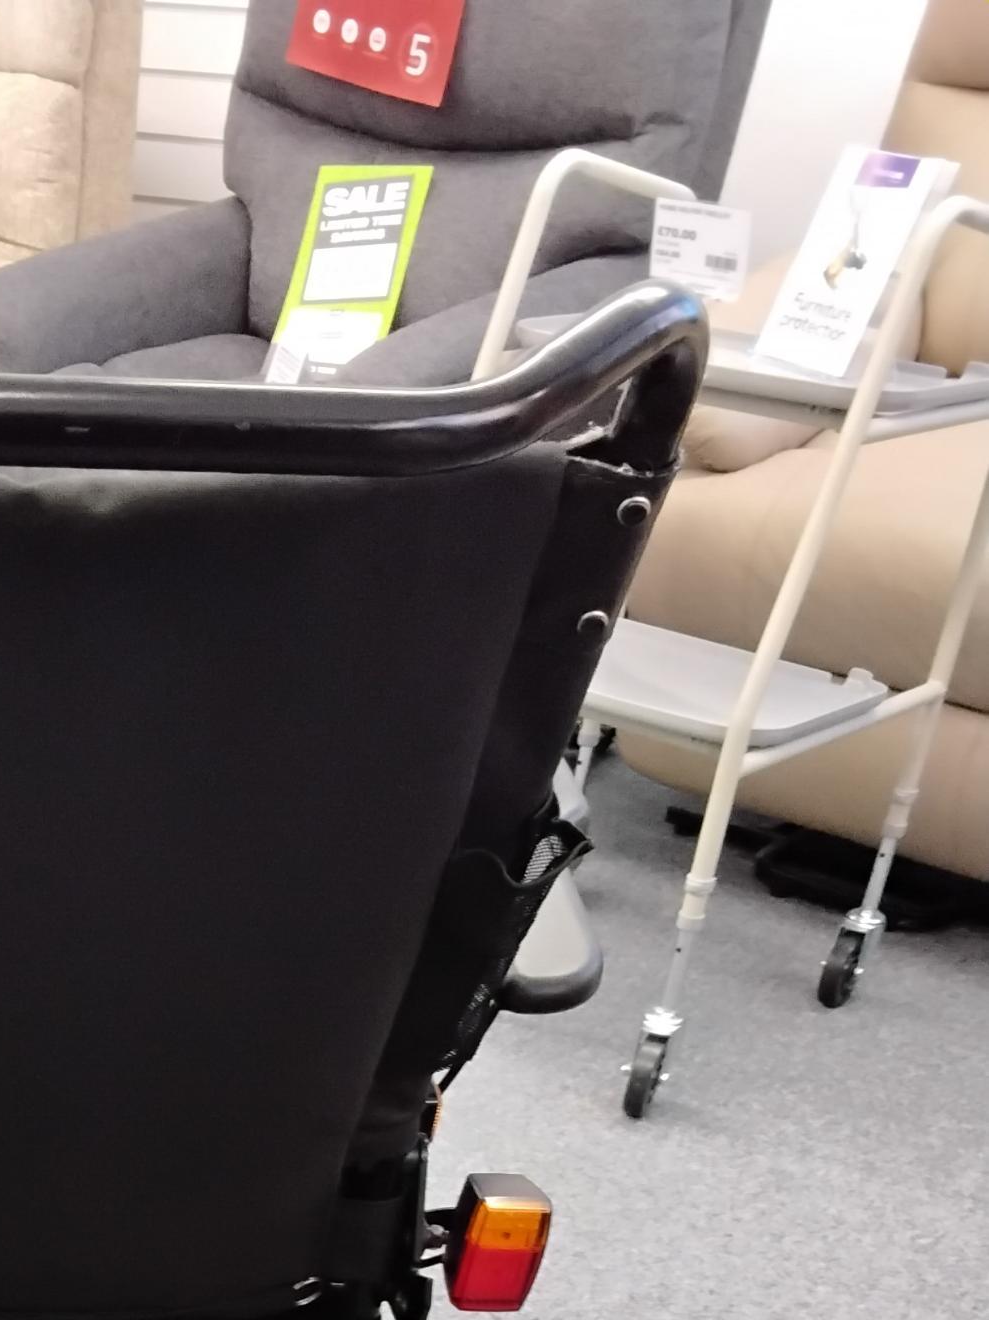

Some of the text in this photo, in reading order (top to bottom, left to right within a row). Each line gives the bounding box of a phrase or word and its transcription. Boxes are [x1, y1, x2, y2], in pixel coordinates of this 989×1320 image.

[405, 33, 431, 76] 5
[322, 181, 410, 217] SALE
[657, 226, 697, 241] £70.00
[794, 291, 852, 323] Furniture
